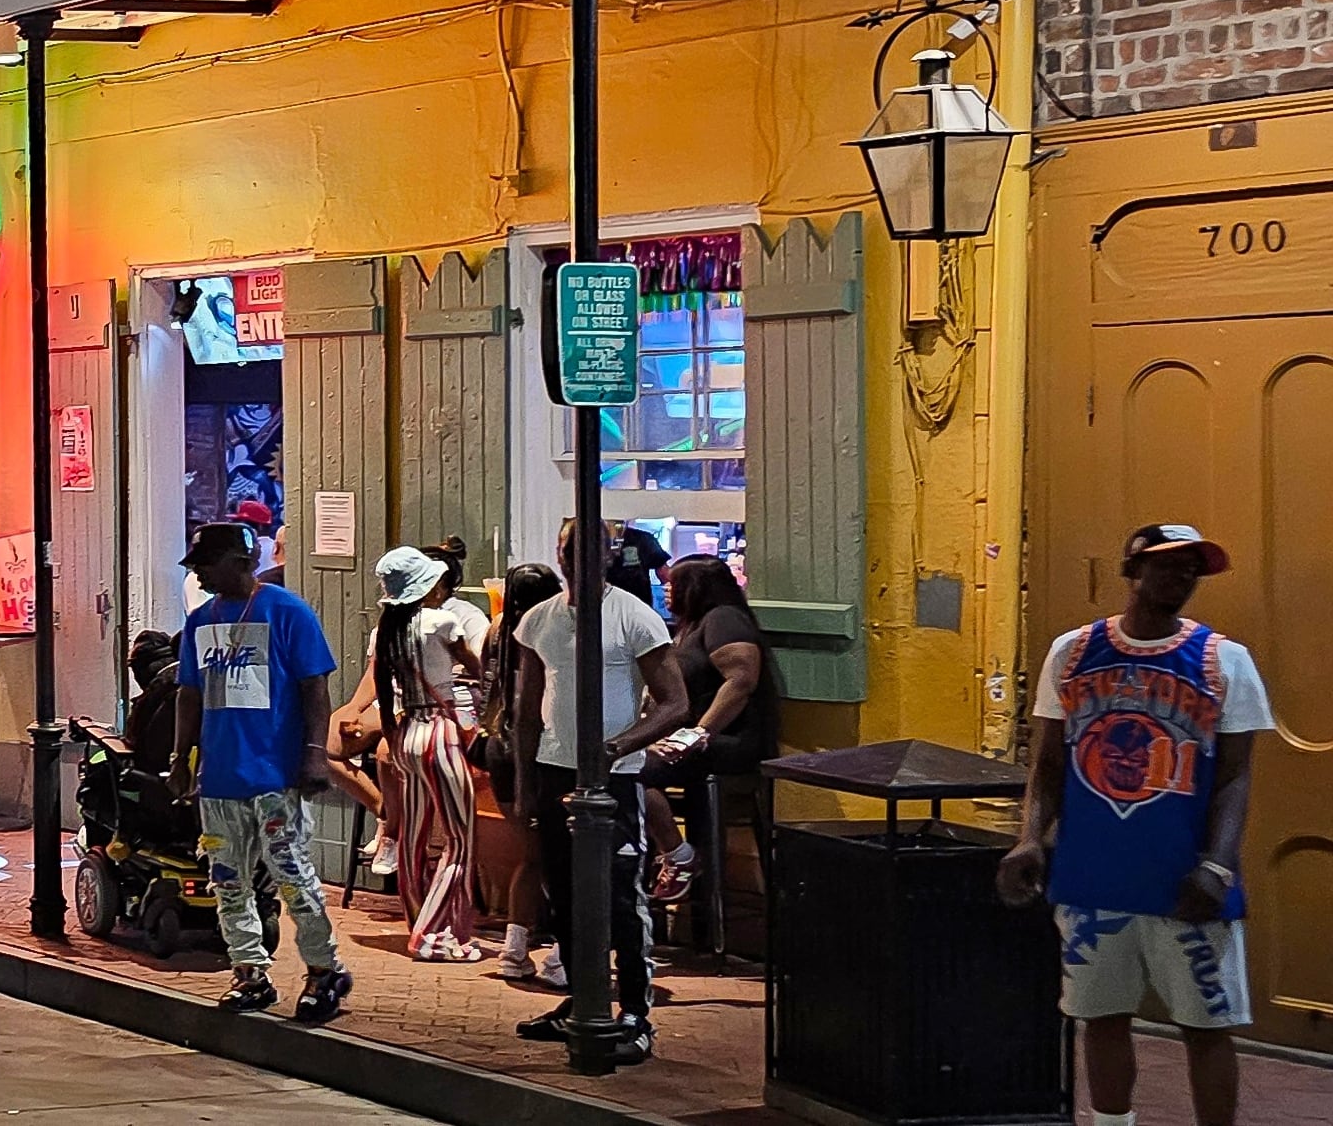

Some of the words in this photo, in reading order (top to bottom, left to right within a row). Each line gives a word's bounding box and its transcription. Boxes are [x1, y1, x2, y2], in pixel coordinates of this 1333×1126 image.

[1199, 220, 1286, 257] 700
[255, 272, 280, 288] BUD
[568, 276, 584, 289] NO
[587, 276, 631, 289] BOTTLES
[250, 288, 279, 301] LIGH
[574, 290, 589, 301] OR
[593, 290, 626, 302] GLASS
[577, 303, 625, 315] ALLOWED
[572, 317, 588, 328] ON
[592, 317, 629, 329] STREET
[1142, 737, 1198, 795] 11
[1175, 928, 1231, 1016] TRUST
